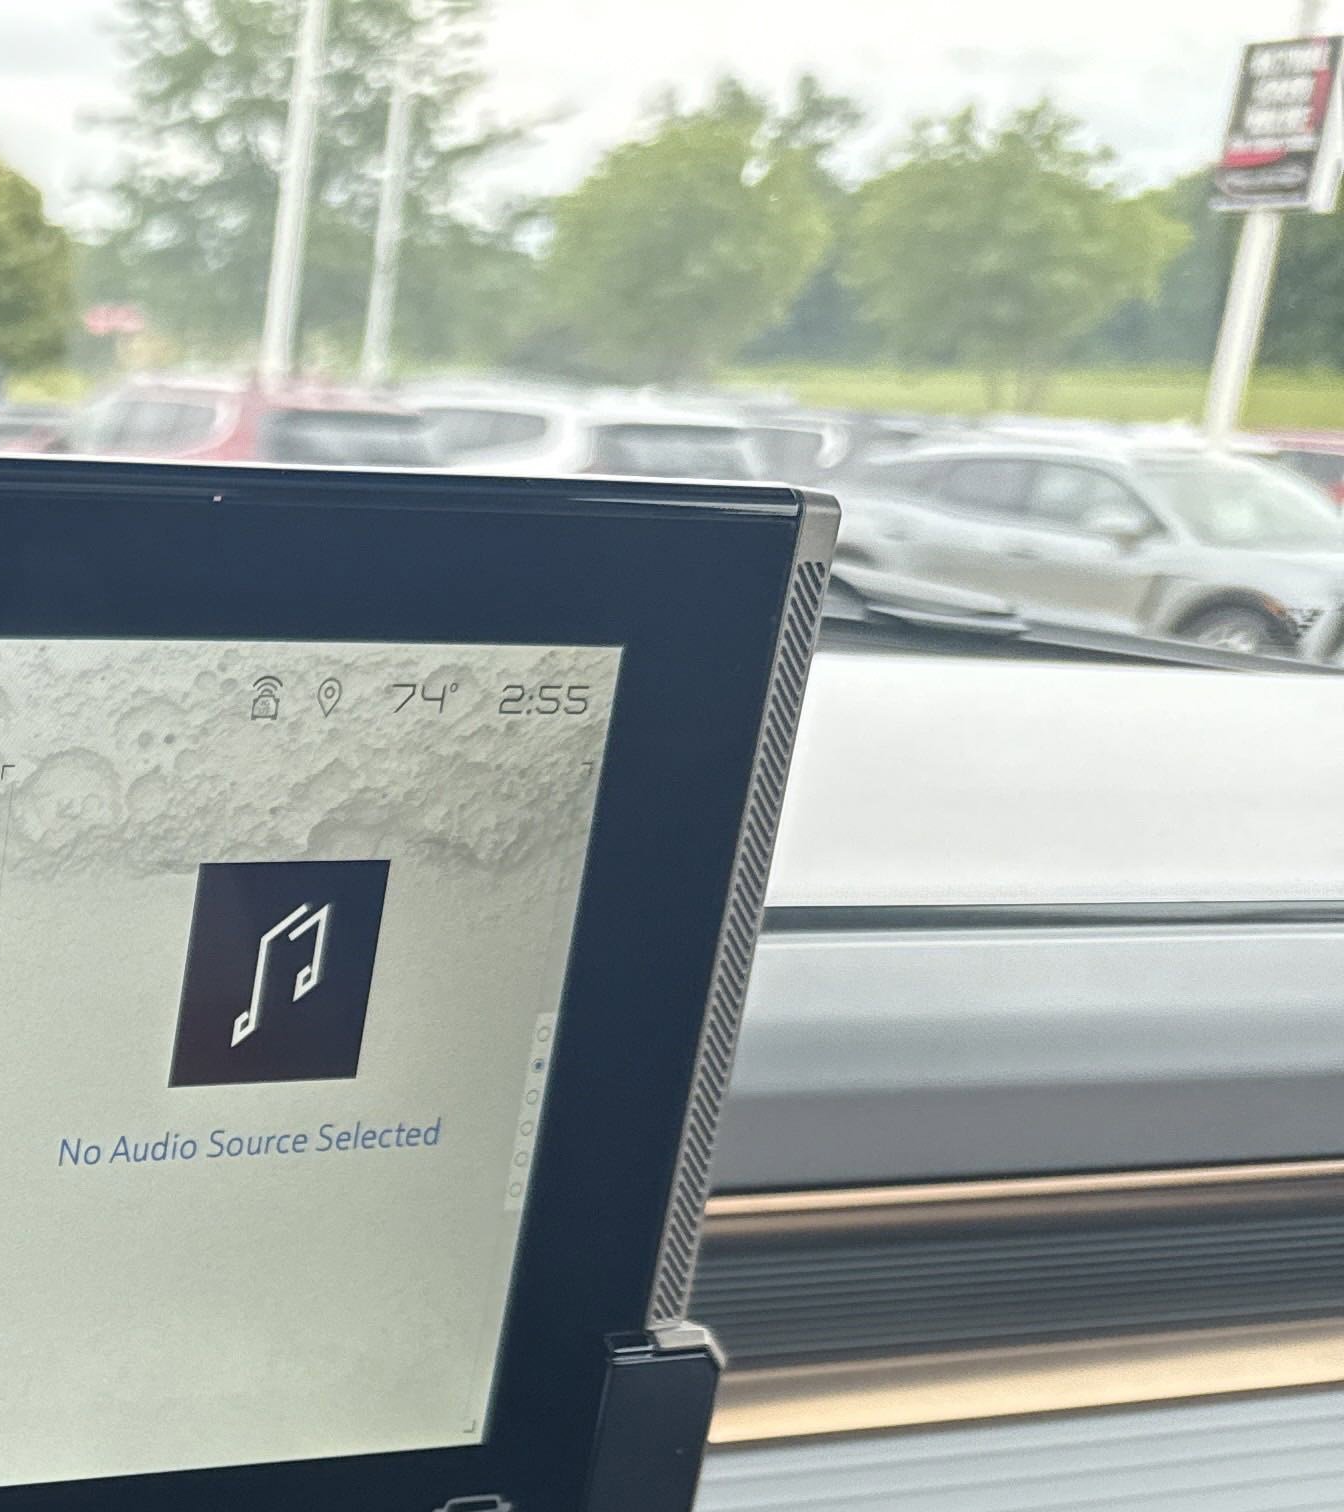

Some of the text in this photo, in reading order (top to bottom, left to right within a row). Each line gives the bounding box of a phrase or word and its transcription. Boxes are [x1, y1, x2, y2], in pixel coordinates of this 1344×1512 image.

[498, 684, 590, 715] 2:55
[57, 1116, 443, 1167] No Audio Source Selected
